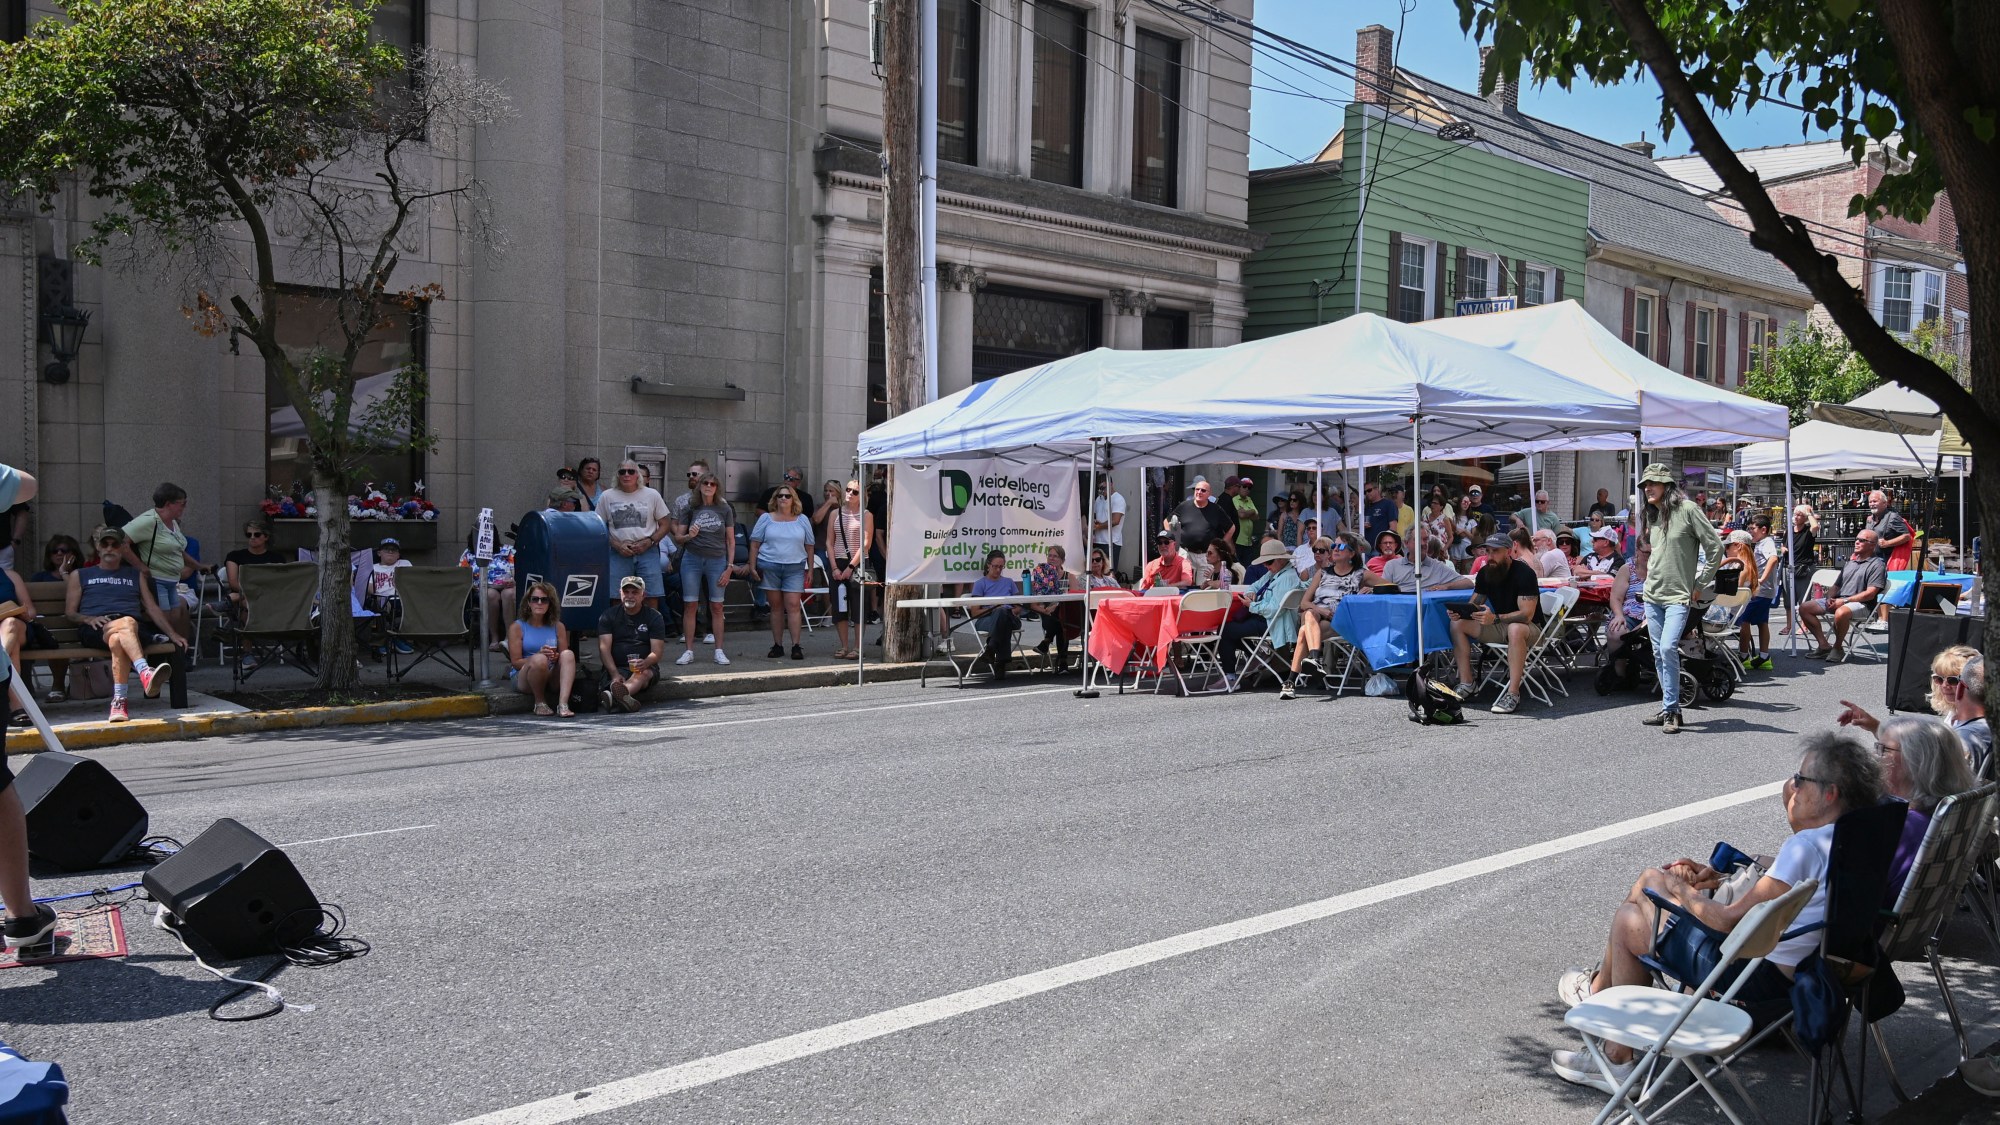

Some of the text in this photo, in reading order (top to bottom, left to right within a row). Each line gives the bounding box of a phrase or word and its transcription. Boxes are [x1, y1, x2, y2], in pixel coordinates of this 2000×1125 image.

[1460, 302, 1510, 316] NAZARETH
[979, 473, 1050, 498] Heidelberg
[973, 492, 1046, 511] Materials
[961, 526, 997, 538] Strong
[999, 526, 1065, 538] Communities
[981, 541, 1053, 557] Supportin
[943, 557, 1035, 572] Local ents
